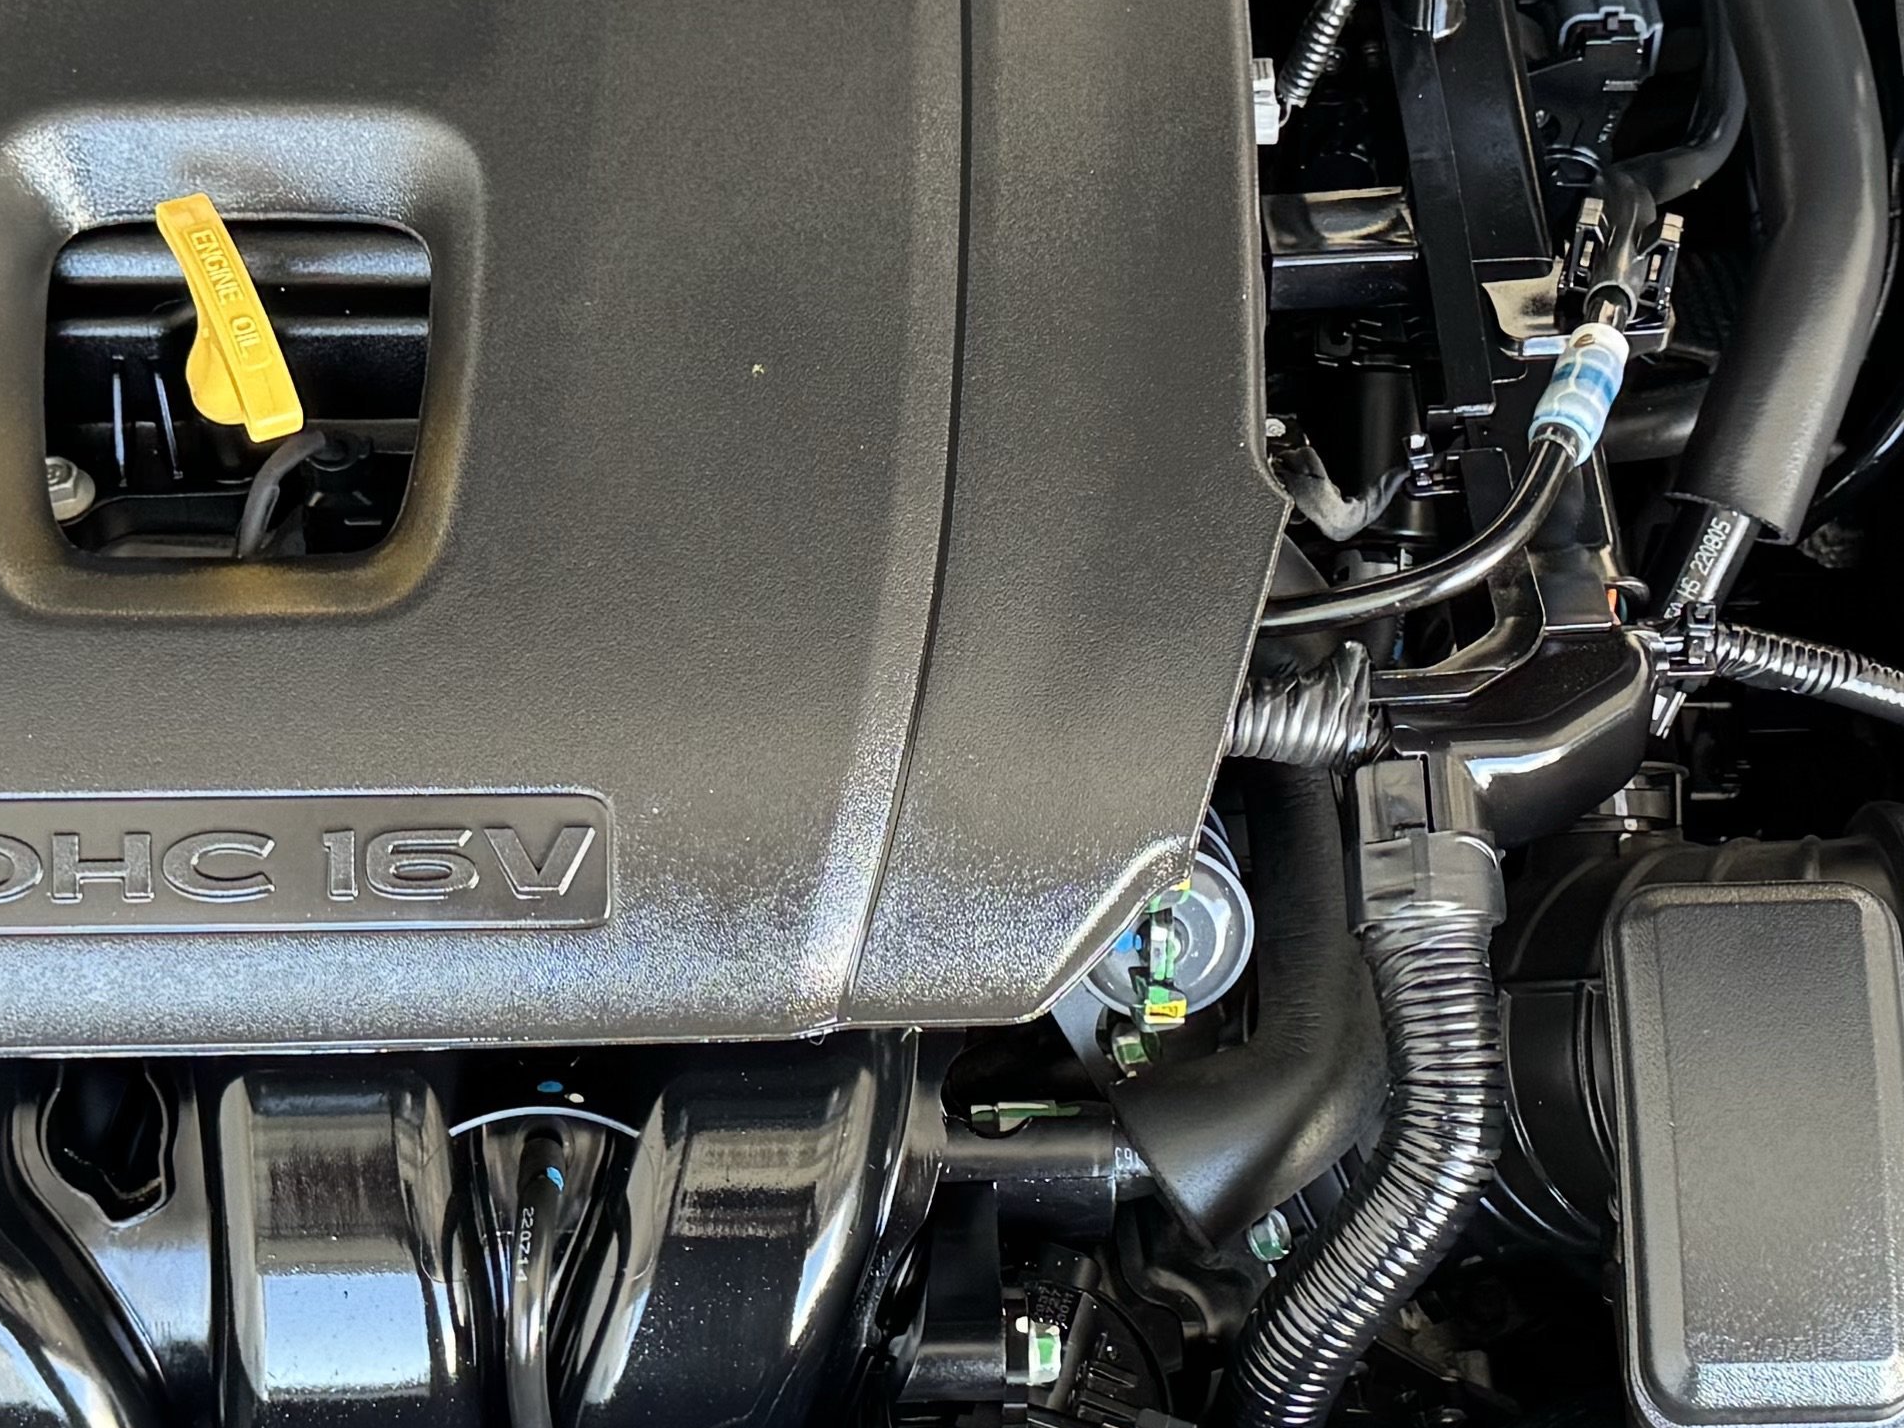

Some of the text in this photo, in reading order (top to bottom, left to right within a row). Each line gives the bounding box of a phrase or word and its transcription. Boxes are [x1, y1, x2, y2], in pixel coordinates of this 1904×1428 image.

[191, 229, 262, 359] ENGINE OIL
[1690, 517, 1731, 576] 220805
[323, 826, 598, 903] 16V
